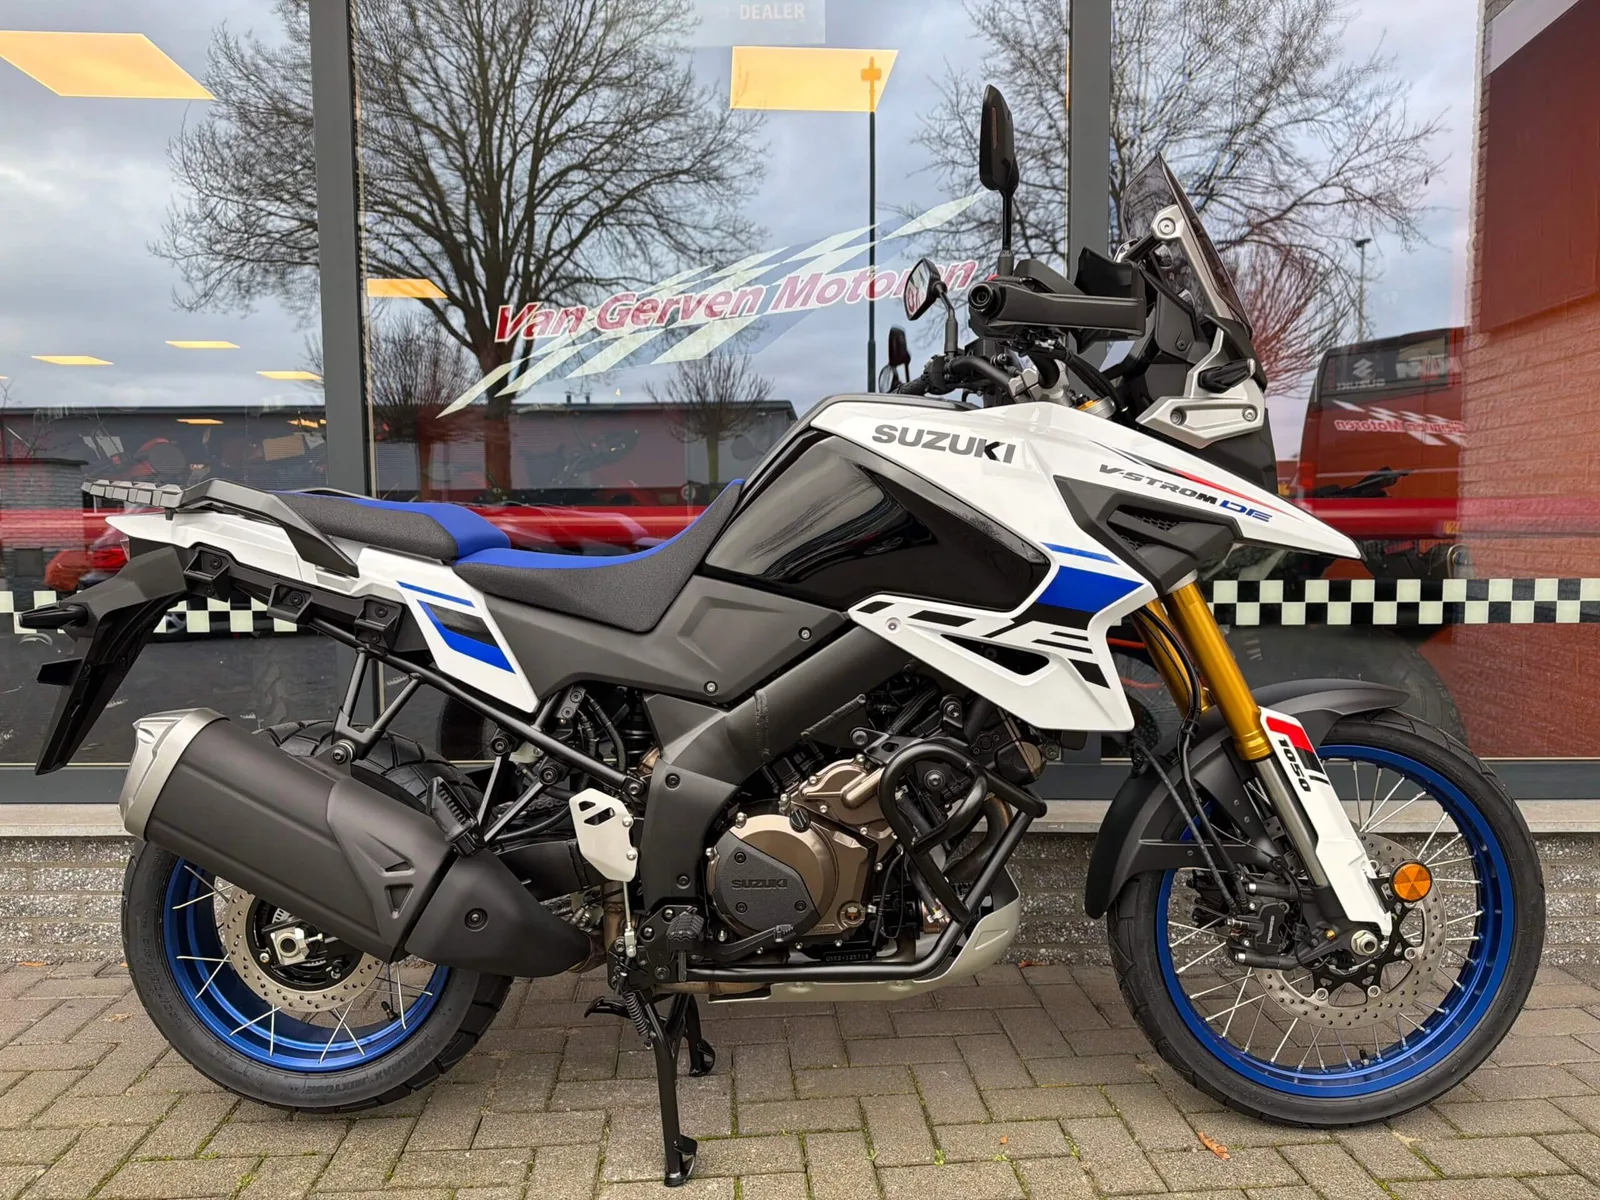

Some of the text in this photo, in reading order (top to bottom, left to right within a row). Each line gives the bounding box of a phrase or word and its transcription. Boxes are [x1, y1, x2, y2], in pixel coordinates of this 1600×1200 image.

[740, 4, 805, 20] DEALER
[494, 302, 588, 342] Van
[595, 284, 766, 332] Gerven
[872, 424, 1017, 464] SUZUKI
[1099, 464, 1273, 523] V-STROM DE
[1278, 738, 1311, 792] 1050
[731, 879, 788, 890] SUZUKI
